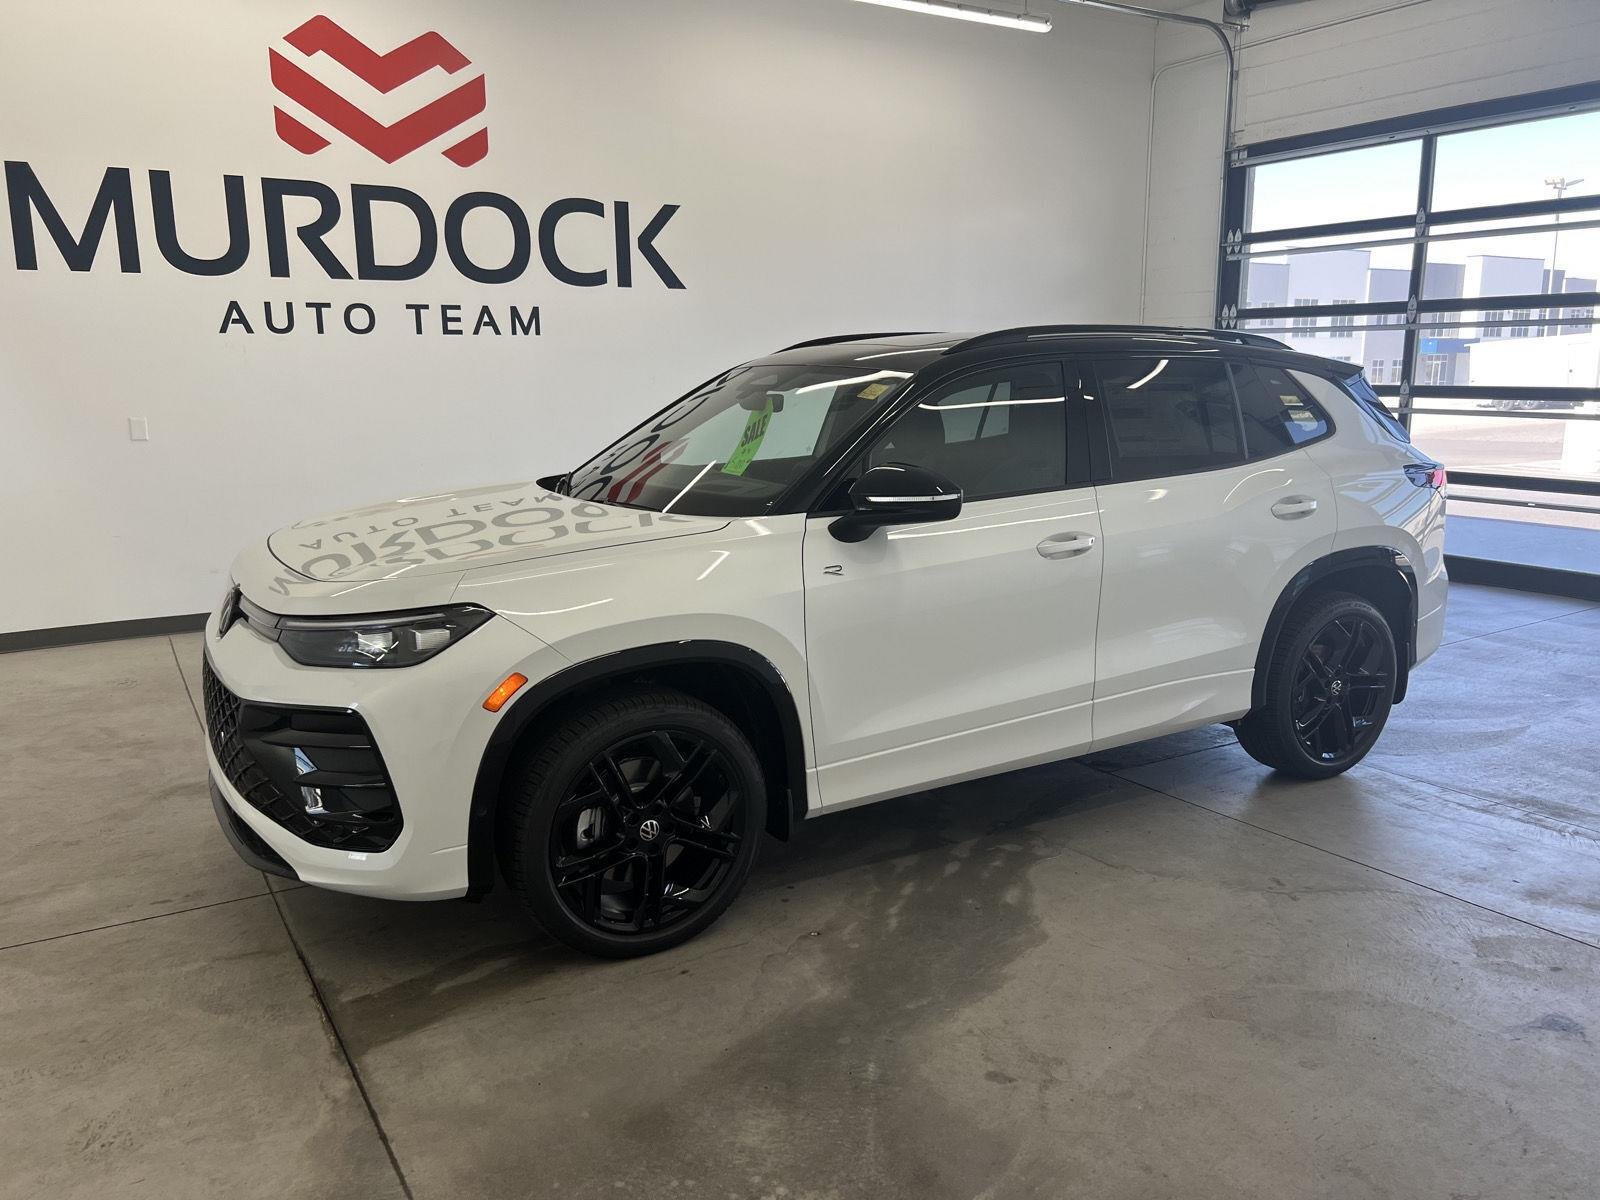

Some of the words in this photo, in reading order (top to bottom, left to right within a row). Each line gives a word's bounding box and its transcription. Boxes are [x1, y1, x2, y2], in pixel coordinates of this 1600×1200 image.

[4, 160, 687, 290] MURDOCK
[218, 300, 376, 335] AUTO
[405, 303, 541, 336] TEAM
[741, 412, 768, 448] SALE
